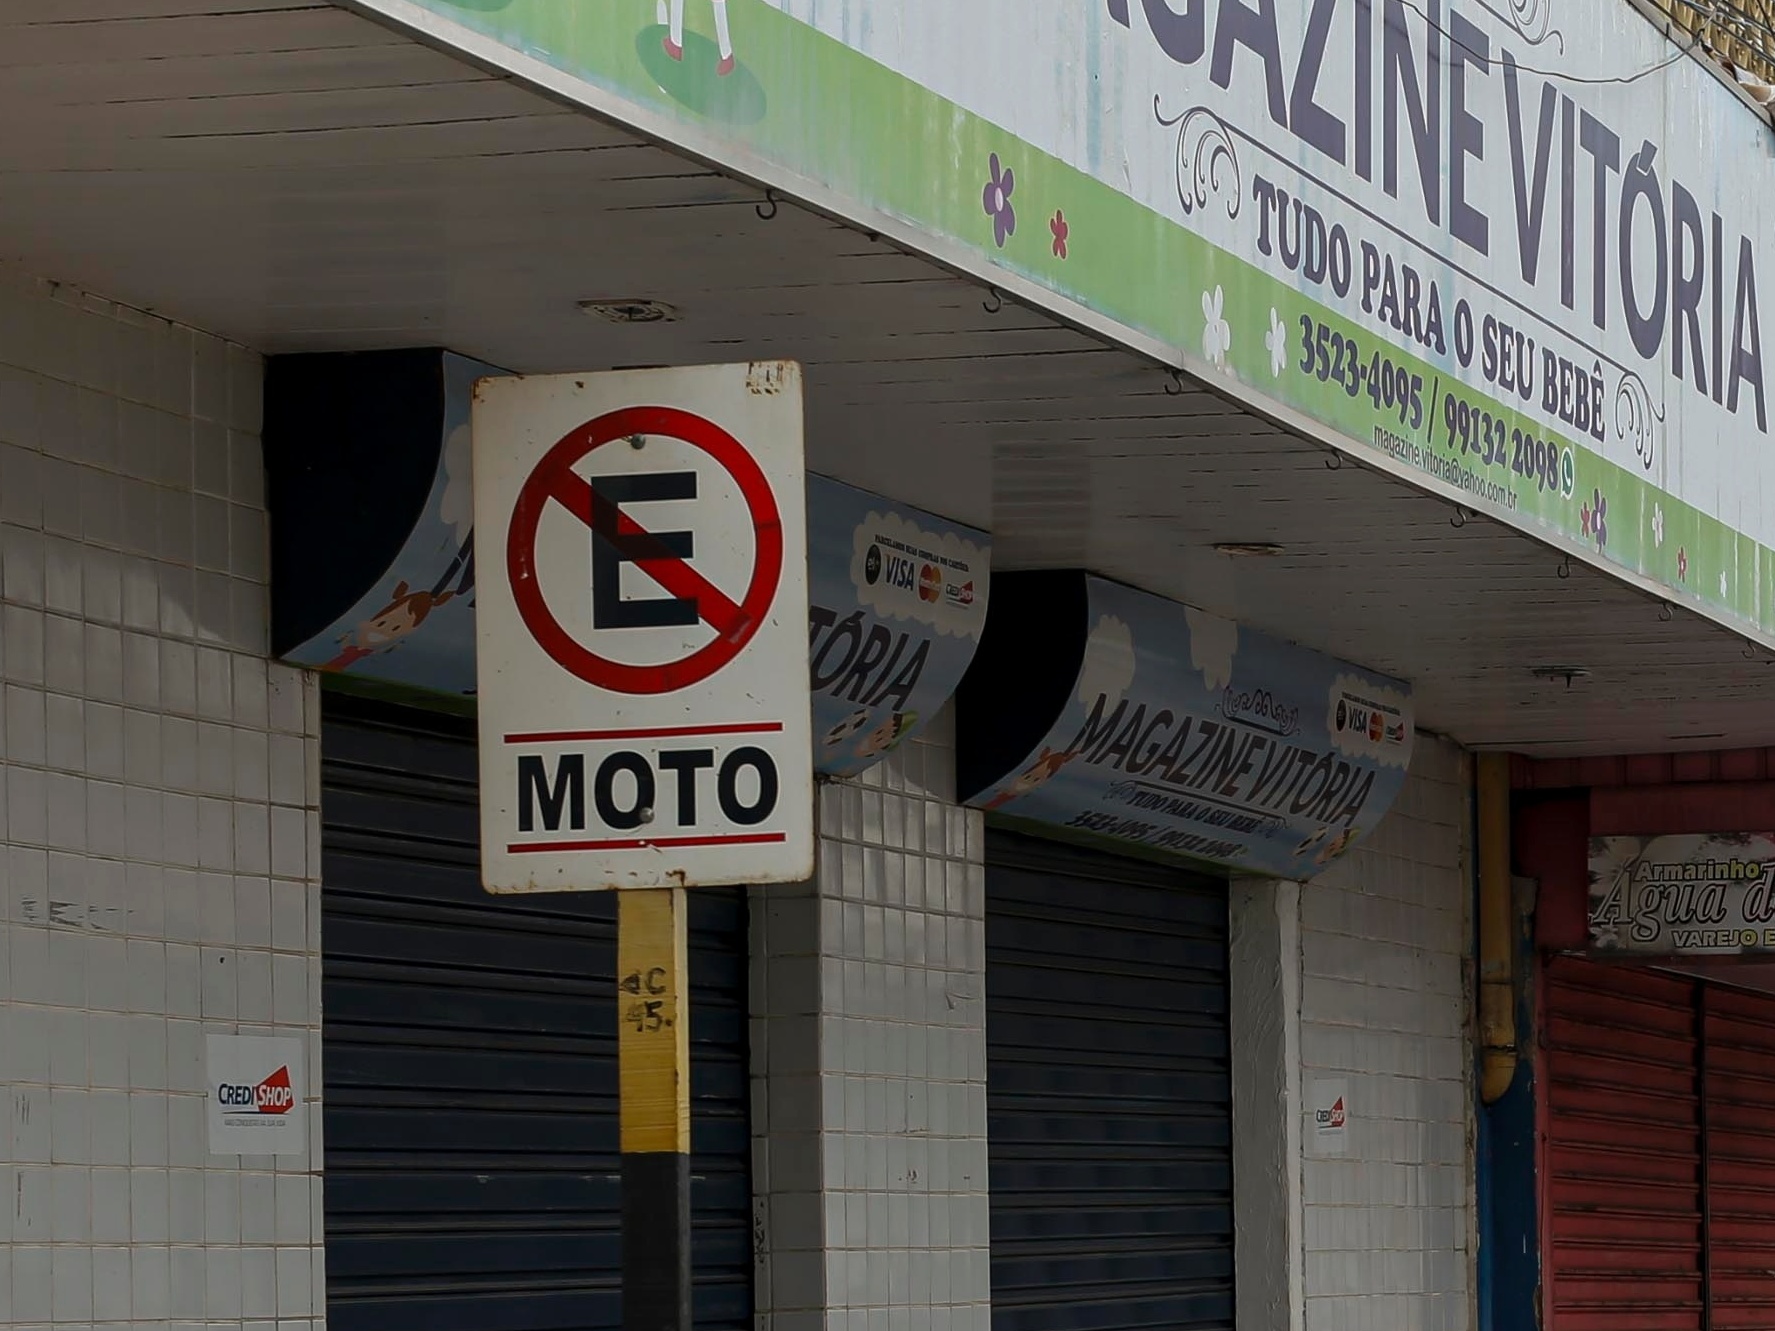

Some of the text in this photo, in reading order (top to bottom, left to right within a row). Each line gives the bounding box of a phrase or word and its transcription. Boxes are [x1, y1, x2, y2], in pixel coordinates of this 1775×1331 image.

[1252, 173, 1605, 442] TUDO PARA O SEU BEBÊ
[1299, 313, 1423, 430] 3523-4095
[1444, 392, 1507, 469] 99132
[1511, 428, 1559, 492] 2098
[592, 471, 699, 629] E
[884, 554, 915, 591] VISA
[517, 746, 779, 832] MOTO
[1592, 855, 1726, 942] Água
[1634, 858, 1759, 882] Armarinho
[1672, 928, 1757, 947] VAREJO
